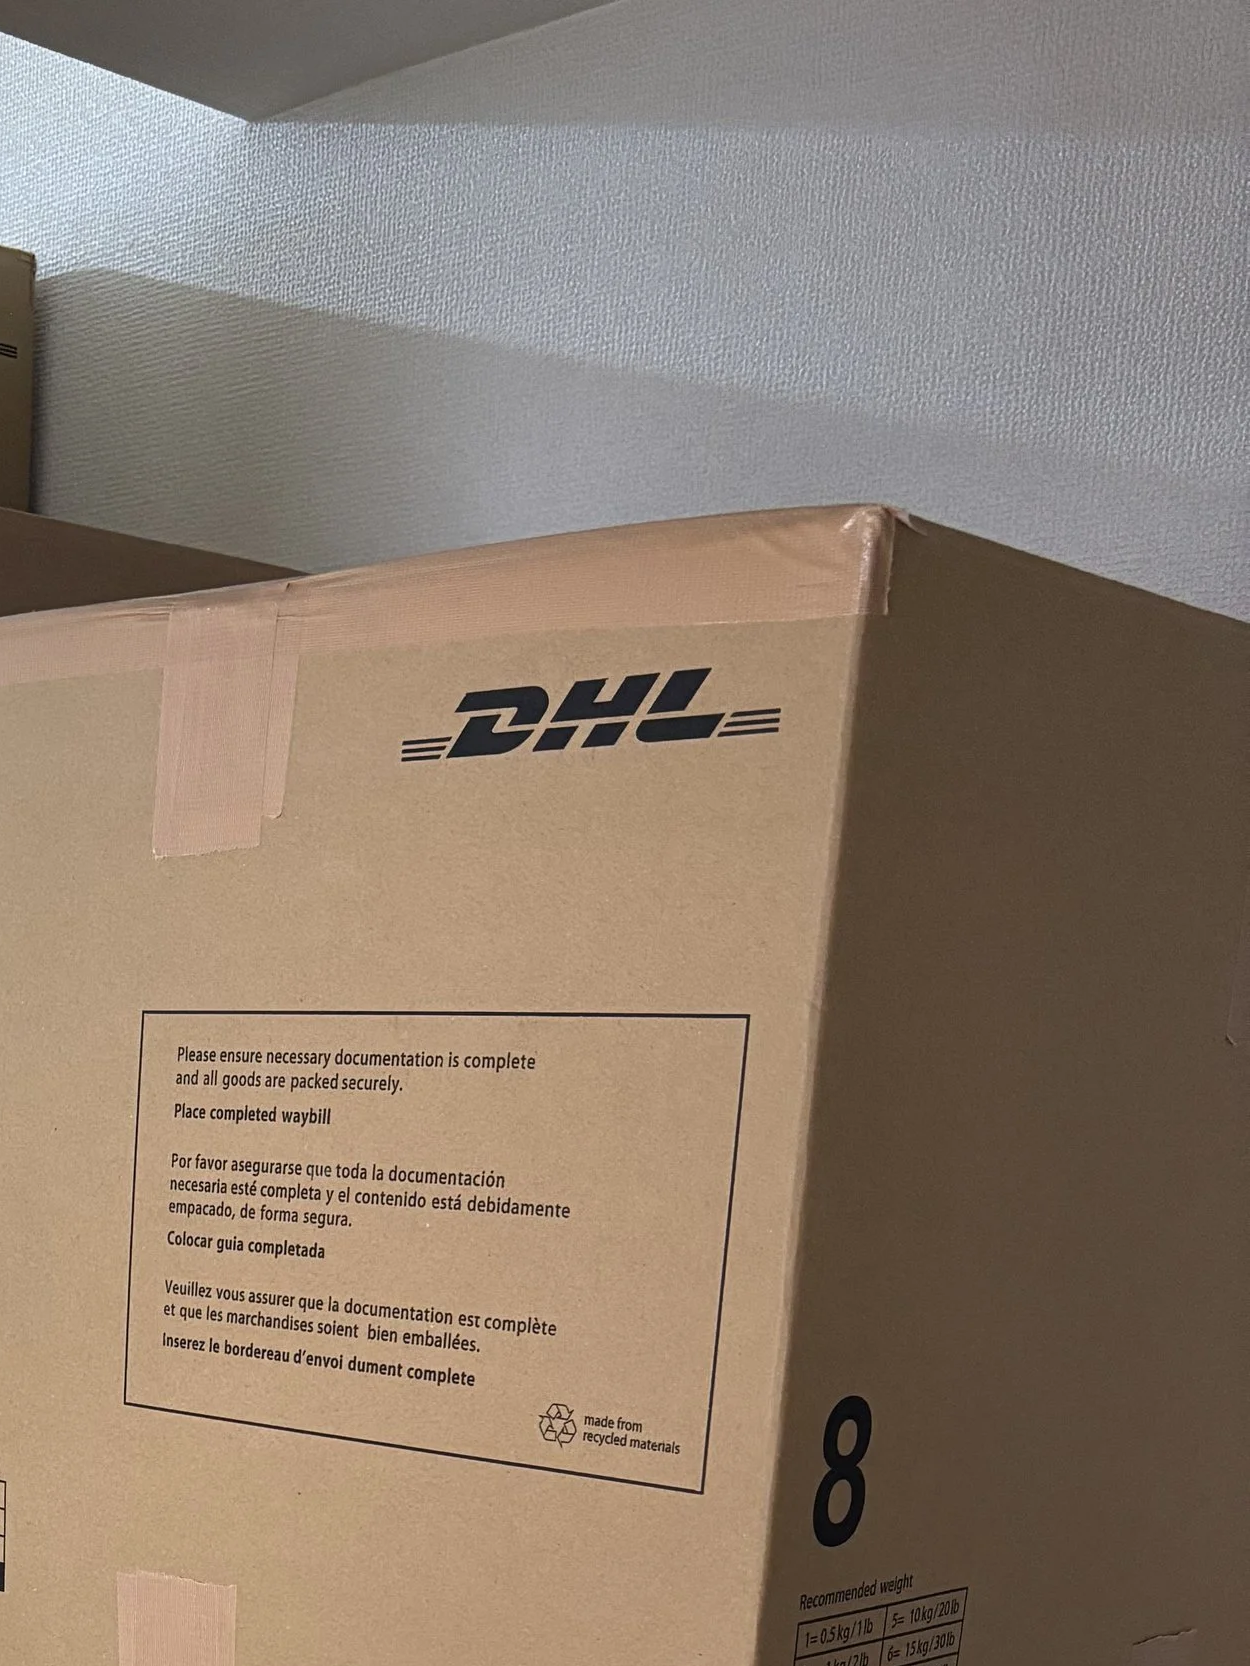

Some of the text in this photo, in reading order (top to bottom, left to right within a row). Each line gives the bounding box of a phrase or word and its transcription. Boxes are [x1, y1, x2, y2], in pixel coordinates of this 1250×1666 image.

[446, 667, 726, 759] DHL
[177, 1046, 537, 1073] Please ensure necessary documentation is complete
[175, 1069, 404, 1096] and all goods are packed securely.
[174, 1102, 331, 1128] Place completed waybill
[171, 1153, 505, 1189] Por favor asegurarse que toda la documentación
[168, 1201, 352, 1229] empacado, de forma segura.
[170, 1178, 571, 1219] necesaria esté completa y el contenido está debidamente
[167, 1230, 325, 1259] Colocar guia completada
[165, 1279, 557, 1337] Veuillez vous assurer que la documentation est complète
[163, 1303, 480, 1353] et que les marchandises soient bien emballées.
[162, 1332, 475, 1387] Inserez le bordereau d’envoi dument complete
[584, 1415, 643, 1432] made from
[582, 1432, 681, 1455] recycled materials
[813, 1395, 872, 1547] 8
[799, 1573, 914, 1611] Recommended weight
